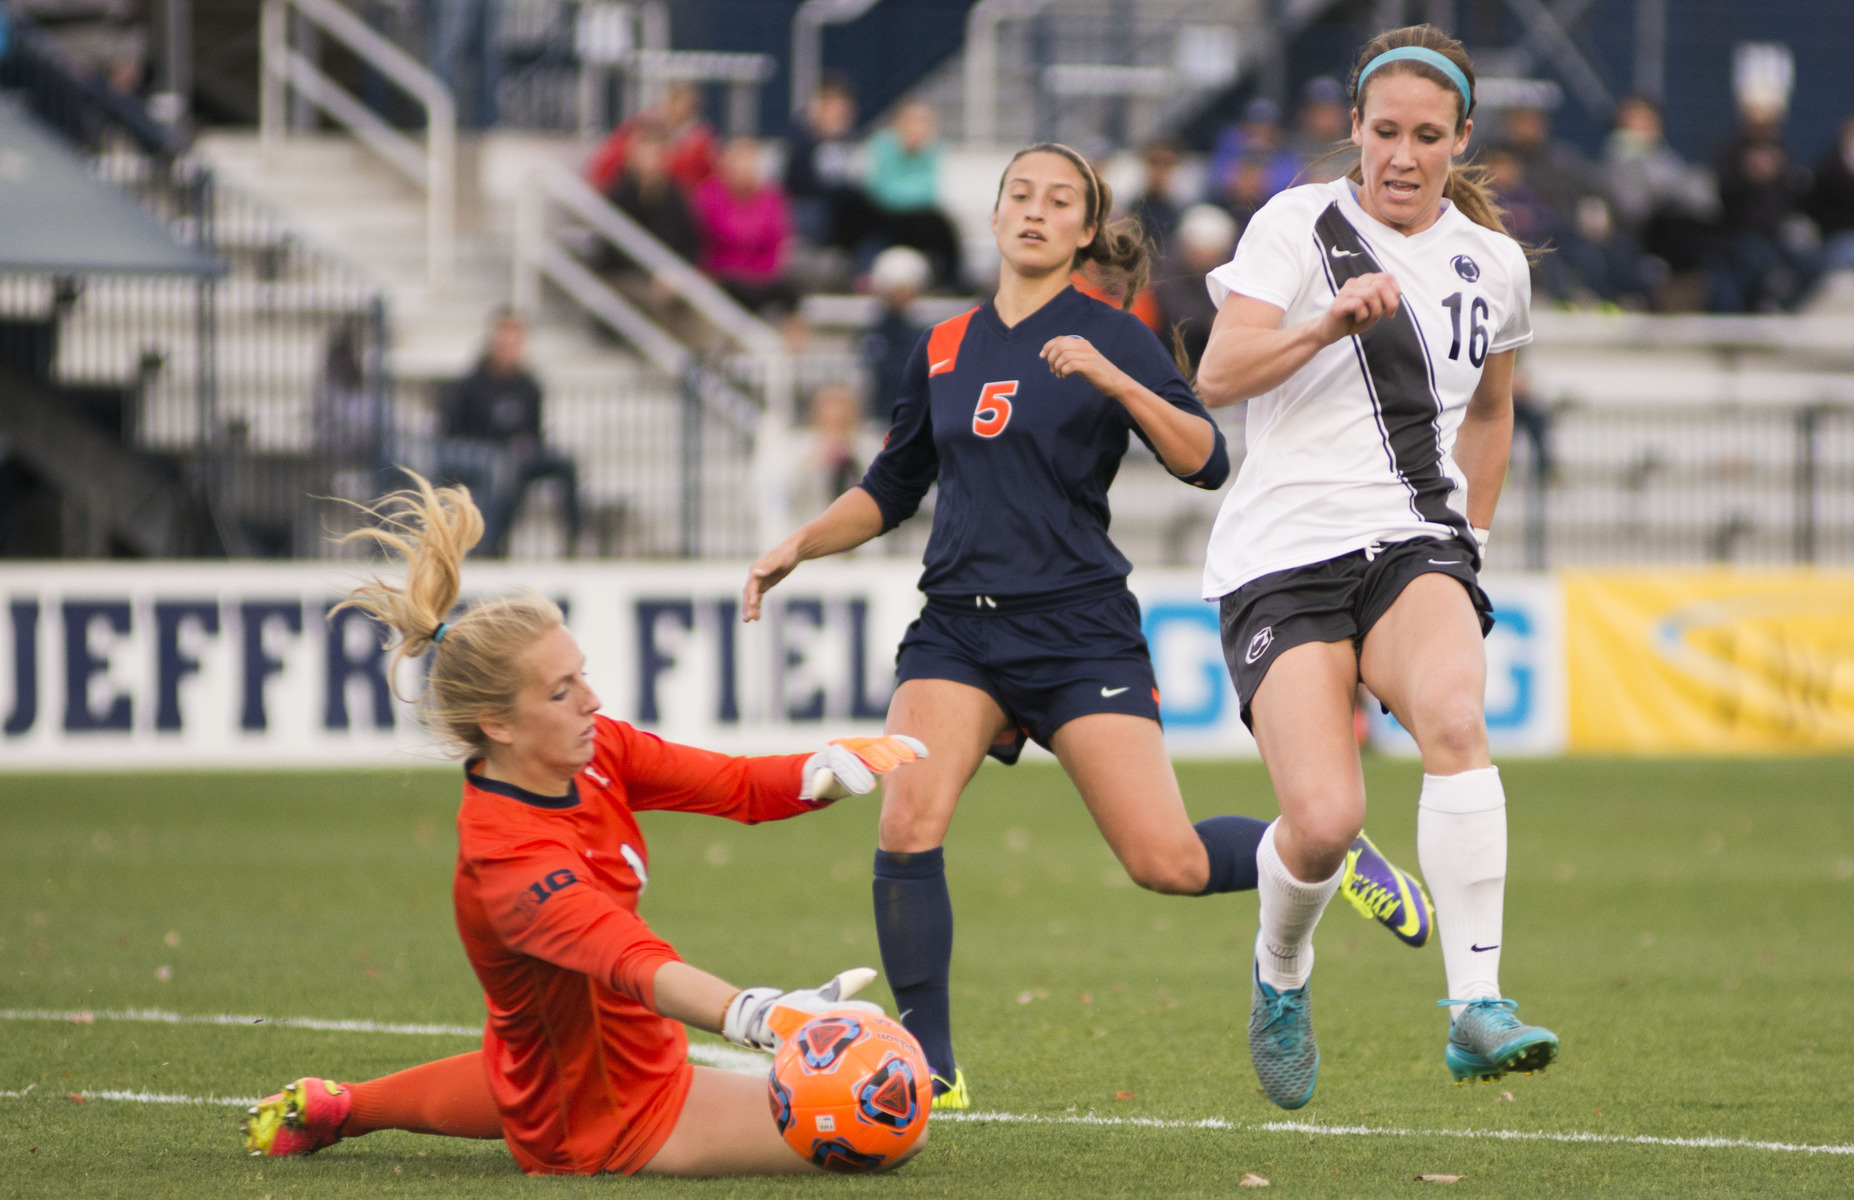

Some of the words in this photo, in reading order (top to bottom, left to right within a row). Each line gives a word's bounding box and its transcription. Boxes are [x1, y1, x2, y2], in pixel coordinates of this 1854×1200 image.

[1441, 292, 1489, 368] 16
[973, 380, 1019, 438] 5
[3, 600, 570, 734] JEFFR
[634, 598, 890, 724] FIEL
